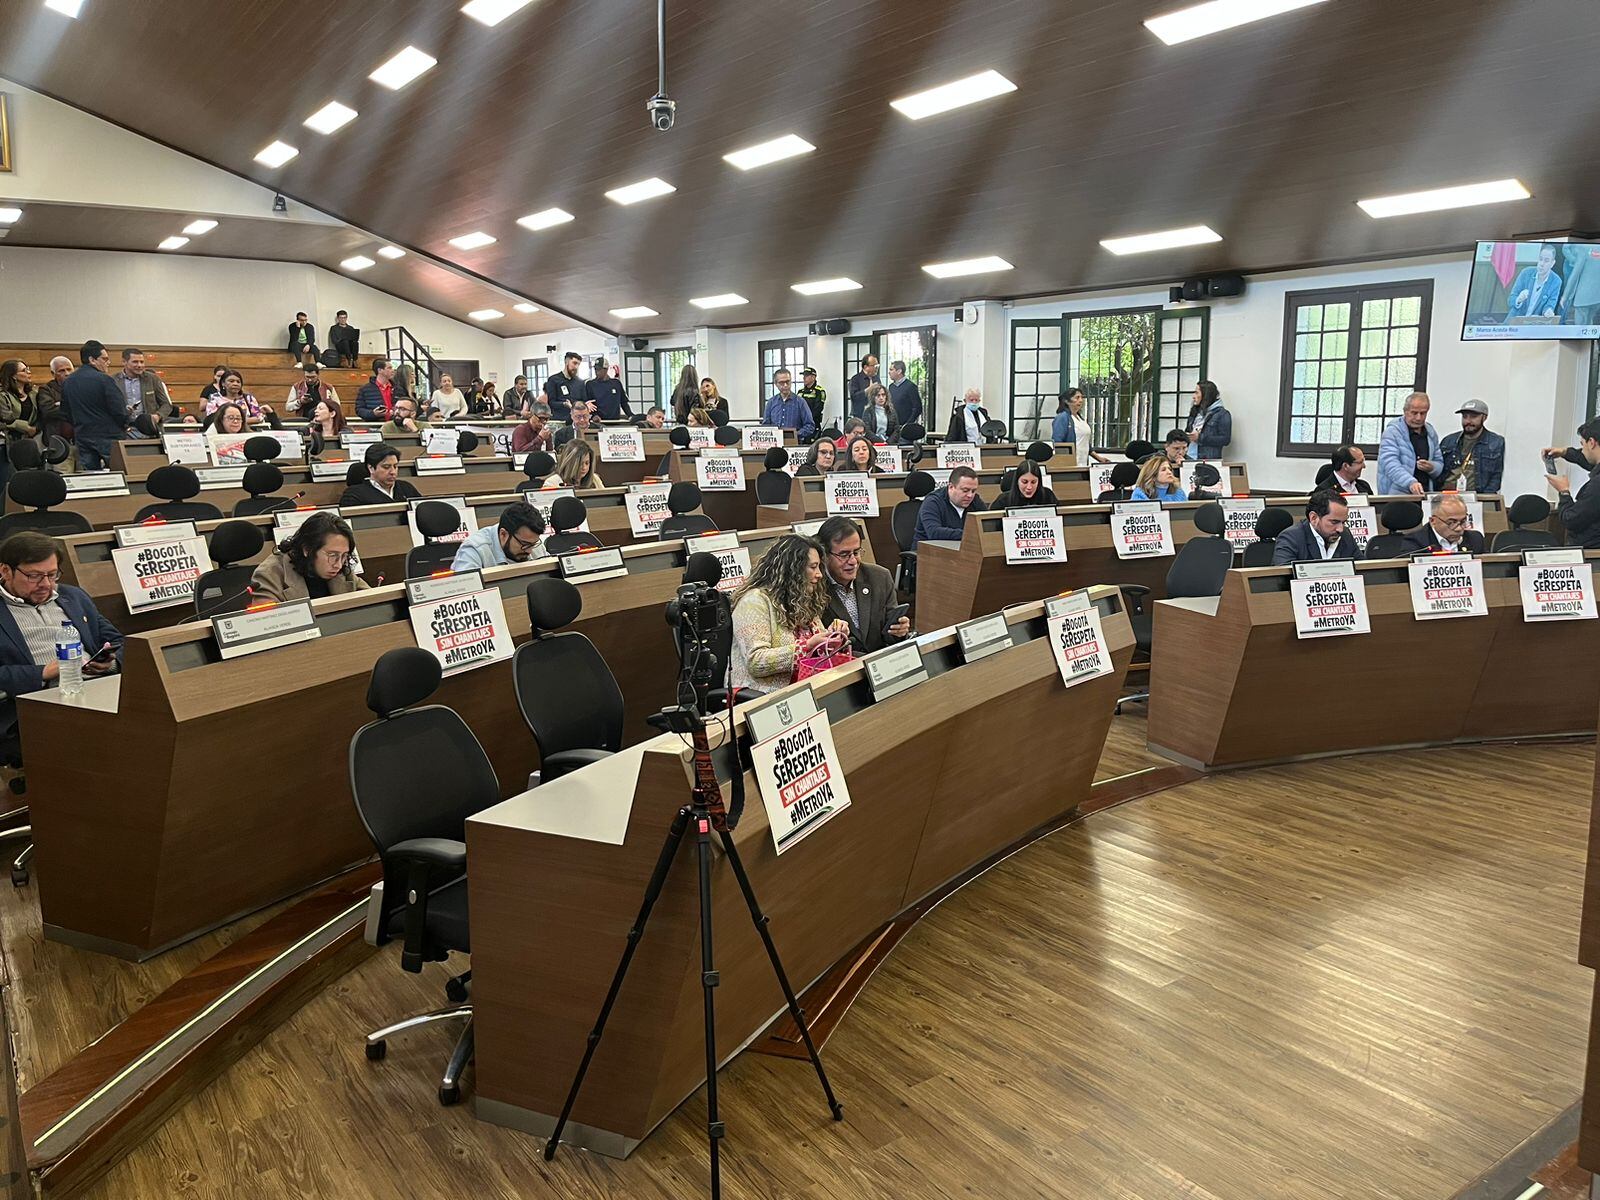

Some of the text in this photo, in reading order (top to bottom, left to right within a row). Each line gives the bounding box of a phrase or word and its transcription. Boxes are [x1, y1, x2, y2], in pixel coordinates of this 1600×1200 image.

[835, 489, 869, 497] SERESPETA
[637, 503, 668, 513] SERESPET
[1018, 518, 1048, 528] #BOGOTÁ
[1126, 514, 1155, 525] #BOGOTÁ
[1225, 521, 1256, 530] SERESPE
[1015, 530, 1054, 539] SERESPETA
[1123, 524, 1161, 535] SERESPETA
[137, 542, 186, 562] #BOGOTÁ
[1021, 547, 1055, 556] #METROYA
[1129, 542, 1162, 551] #METROYA
[134, 555, 198, 578] SERESPETA
[1427, 563, 1464, 576] #BOGOTÁ
[1538, 567, 1574, 579] #BOGOTÁ
[1309, 579, 1347, 593] #BOGOTÁ
[1423, 576, 1472, 589] SERESPETA
[1534, 580, 1582, 592] SERESPETA
[149, 581, 194, 600] #METROY
[1306, 592, 1355, 607] SERESPETA
[1431, 598, 1472, 610] #METROYA
[433, 595, 480, 620] #BOGOTÁ
[1542, 601, 1583, 612] #METROYA
[431, 611, 492, 638] SERESPETA
[1062, 612, 1088, 632] #BOGOTÁ
[1314, 615, 1355, 628] #METROYA
[440, 627, 490, 649] SIN CHANTAJES
[1060, 627, 1096, 649] SERESPETA
[445, 639, 495, 664] #METROYA
[1072, 654, 1101, 673] #METROYA
[774, 722, 814, 763] #BOGOTÁ
[773, 742, 826, 790] SERESPETA
[783, 767, 826, 804] SIN CHANTAJES
[790, 782, 834, 826] #METROYA
